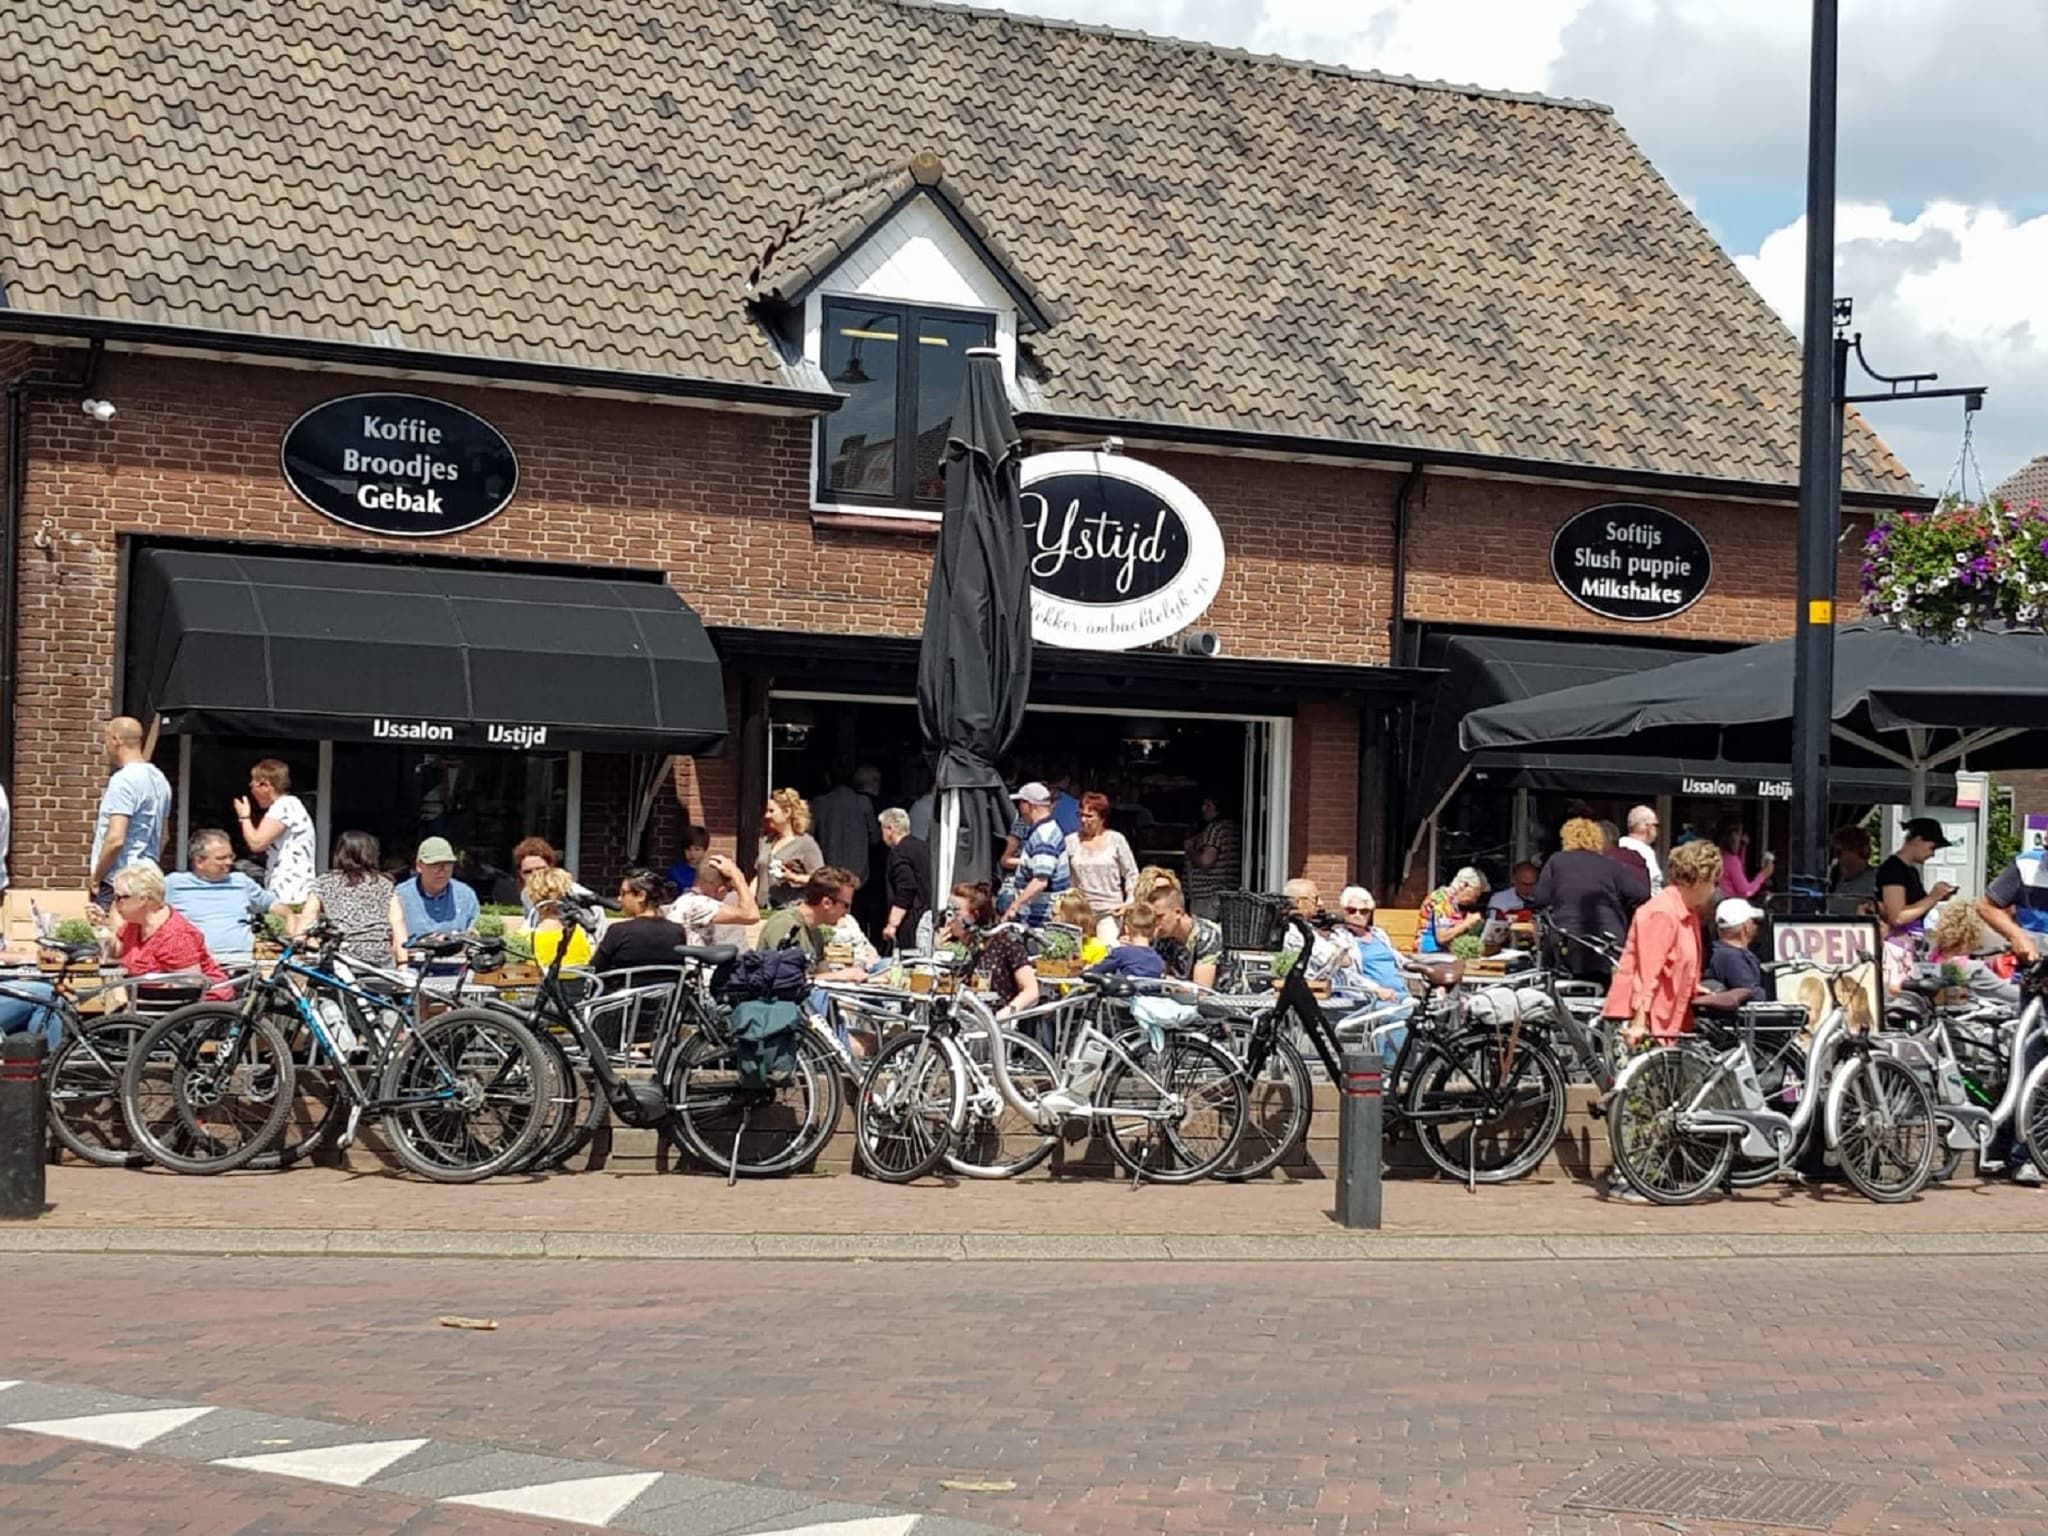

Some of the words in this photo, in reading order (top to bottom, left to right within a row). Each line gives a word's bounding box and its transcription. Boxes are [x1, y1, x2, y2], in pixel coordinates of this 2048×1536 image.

[363, 415, 443, 445] Koffie
[343, 448, 459, 486] Broodjes
[356, 484, 444, 515] Gebak
[1606, 521, 1662, 550] Softijs
[1574, 547, 1621, 569] Slush
[1627, 556, 1692, 580] puppie
[1581, 577, 1683, 604] Milkshakes
[373, 718, 454, 741] IJssalon
[488, 724, 548, 749] IJstijd
[1778, 927, 1866, 965] OPEN
